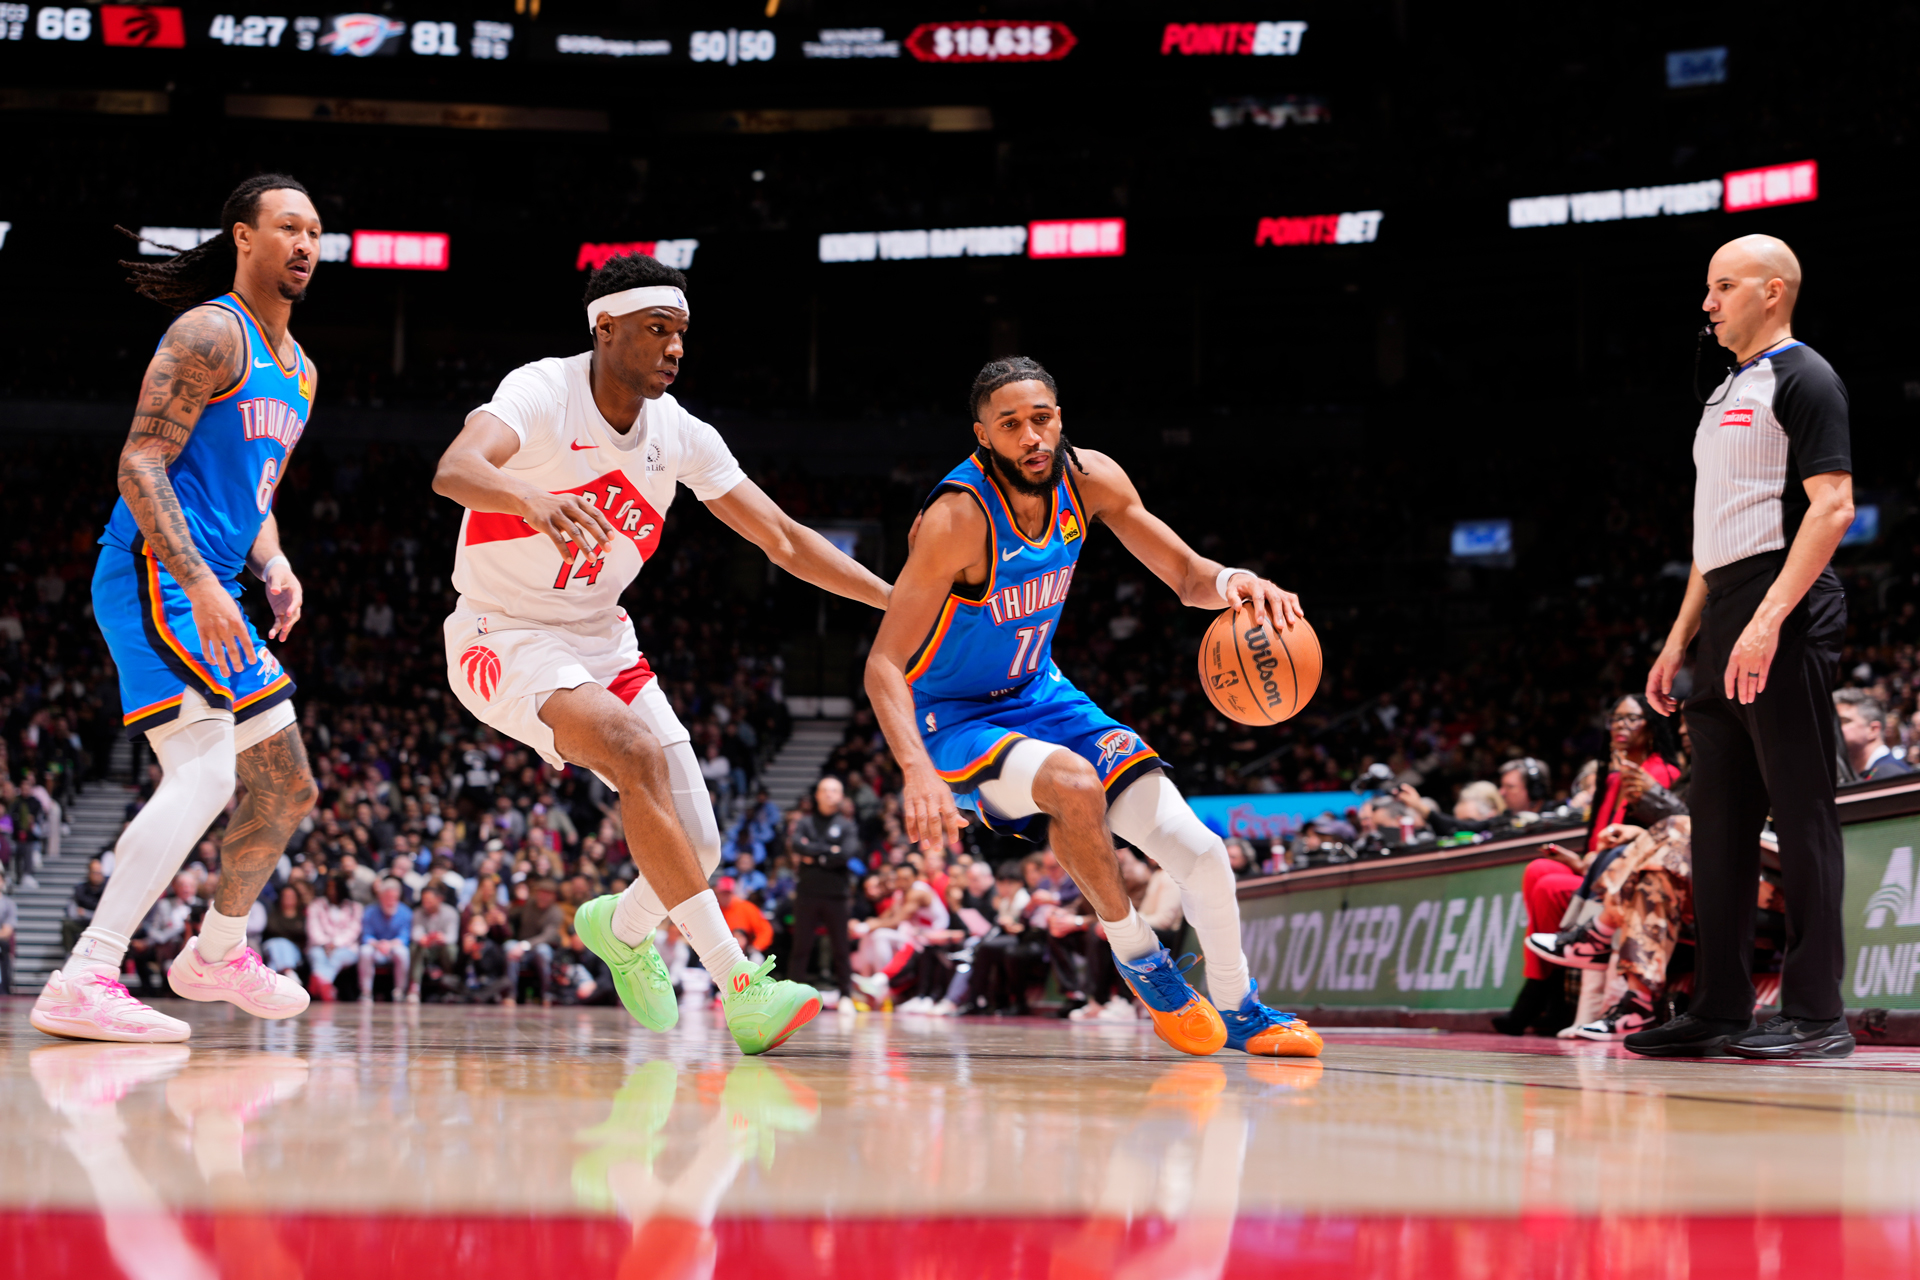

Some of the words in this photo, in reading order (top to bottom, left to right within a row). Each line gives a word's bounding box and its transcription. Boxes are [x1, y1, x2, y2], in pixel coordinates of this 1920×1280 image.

[37, 6, 92, 41] 66
[209, 14, 288, 47] 4:27
[410, 21, 460, 56] 81
[131, 415, 190, 446] OMETOWN
[237, 397, 303, 456] THUNDE
[1721, 412, 1752, 424] Emirates
[256, 458, 277, 514] 6
[553, 540, 605, 590] 14
[1008, 620, 1052, 679] 11
[1244, 625, 1283, 709] Wilson
[1278, 910, 1323, 992] TO
[1317, 904, 1401, 991] KEEP
[1396, 891, 1523, 991] CLEAN
